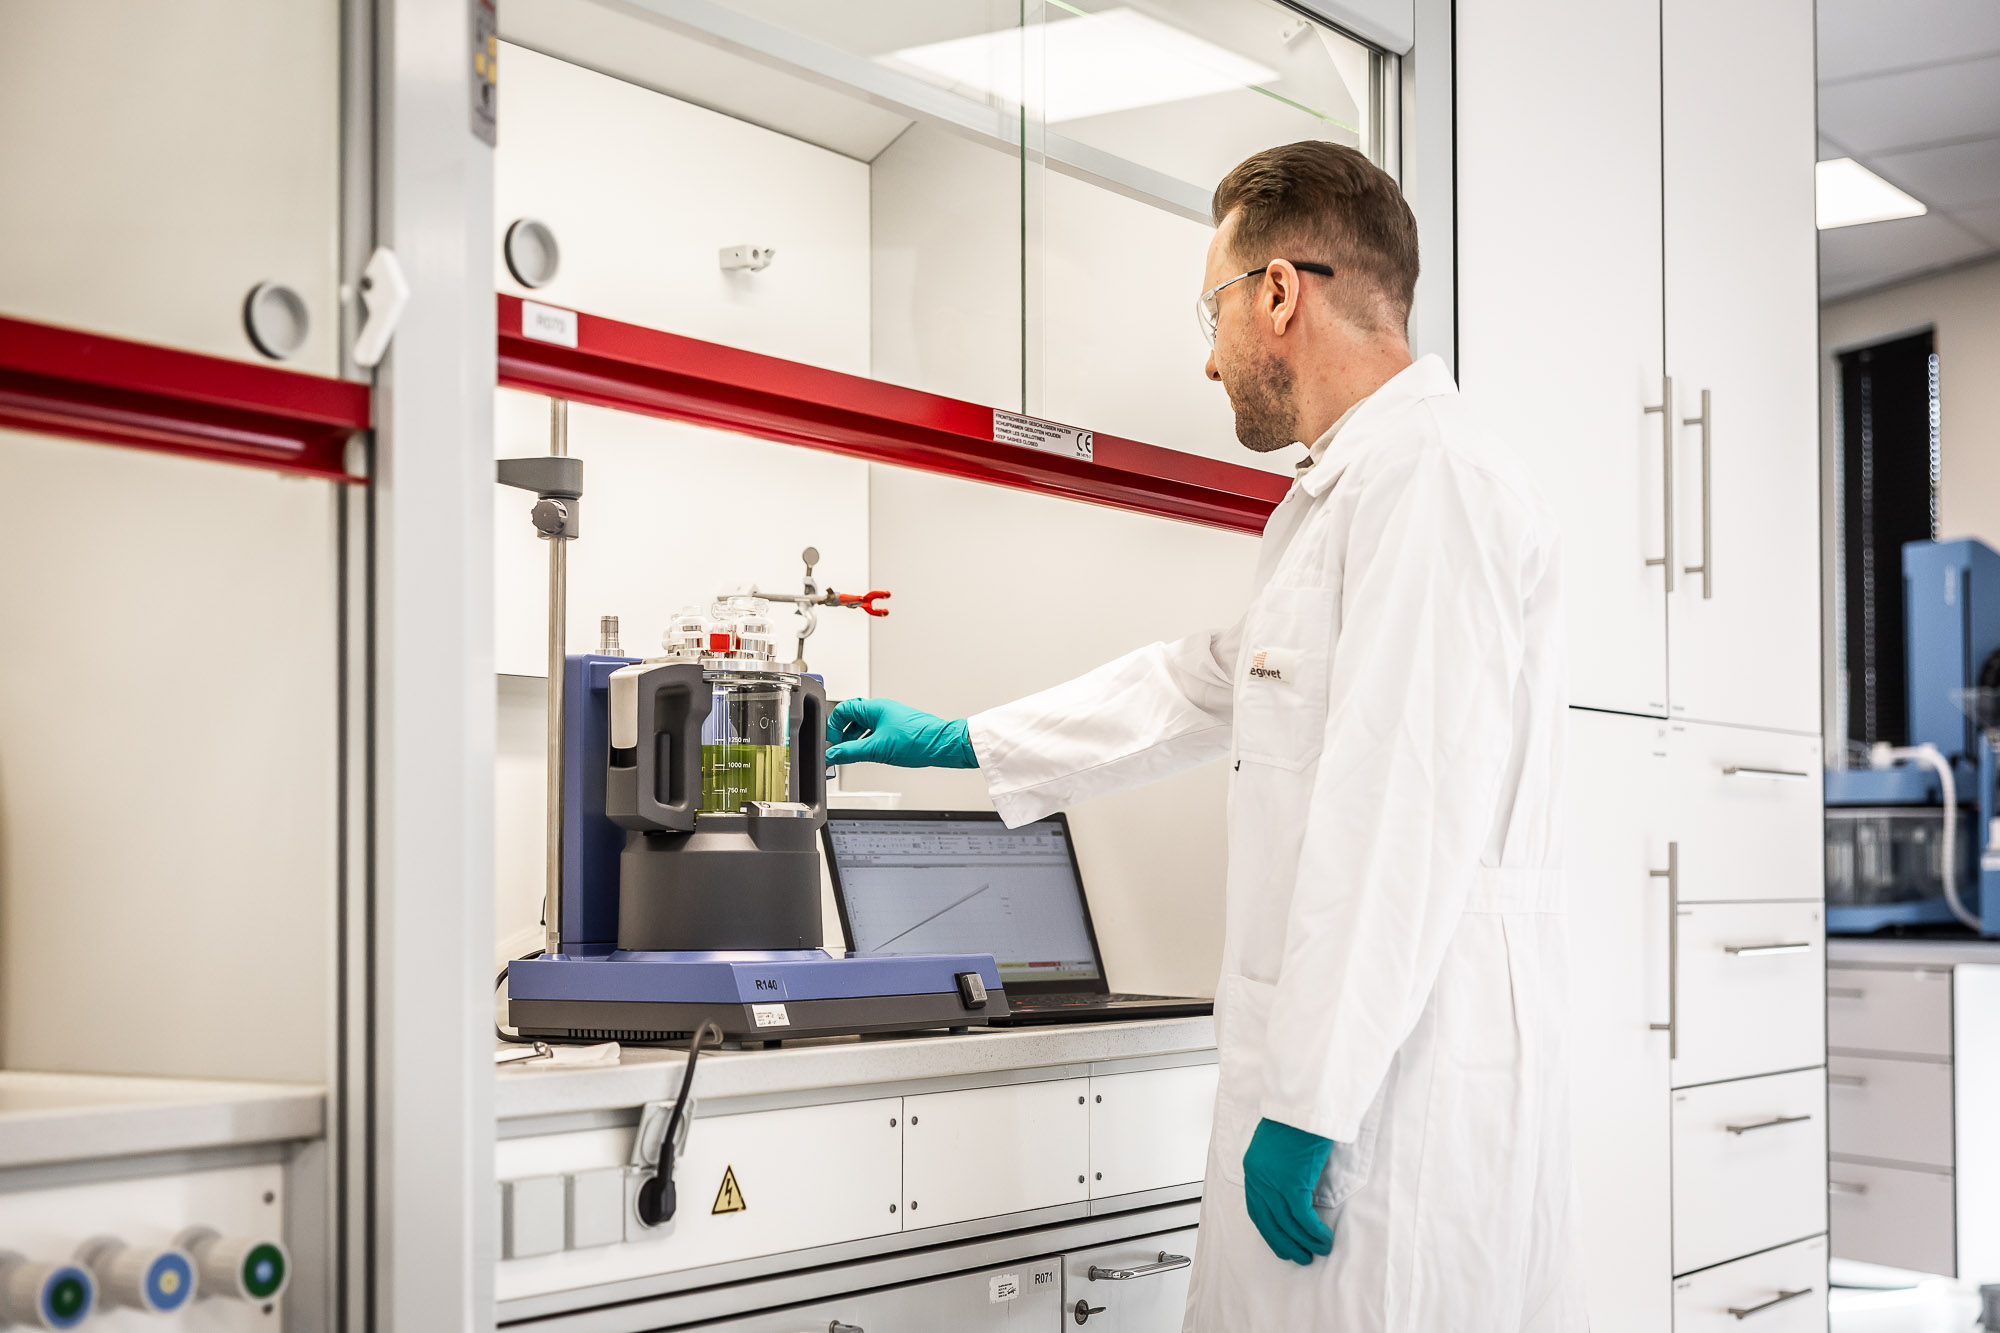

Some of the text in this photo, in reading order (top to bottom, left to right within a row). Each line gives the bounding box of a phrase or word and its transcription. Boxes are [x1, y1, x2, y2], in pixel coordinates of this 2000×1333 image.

[1028, 420, 1057, 432] GESCHLOSSEN
[1056, 427, 1072, 435] HALTEN
[1022, 439, 1039, 448] CLOSED
[755, 979, 778, 991] R140
[1034, 1271, 1054, 1285] R071
